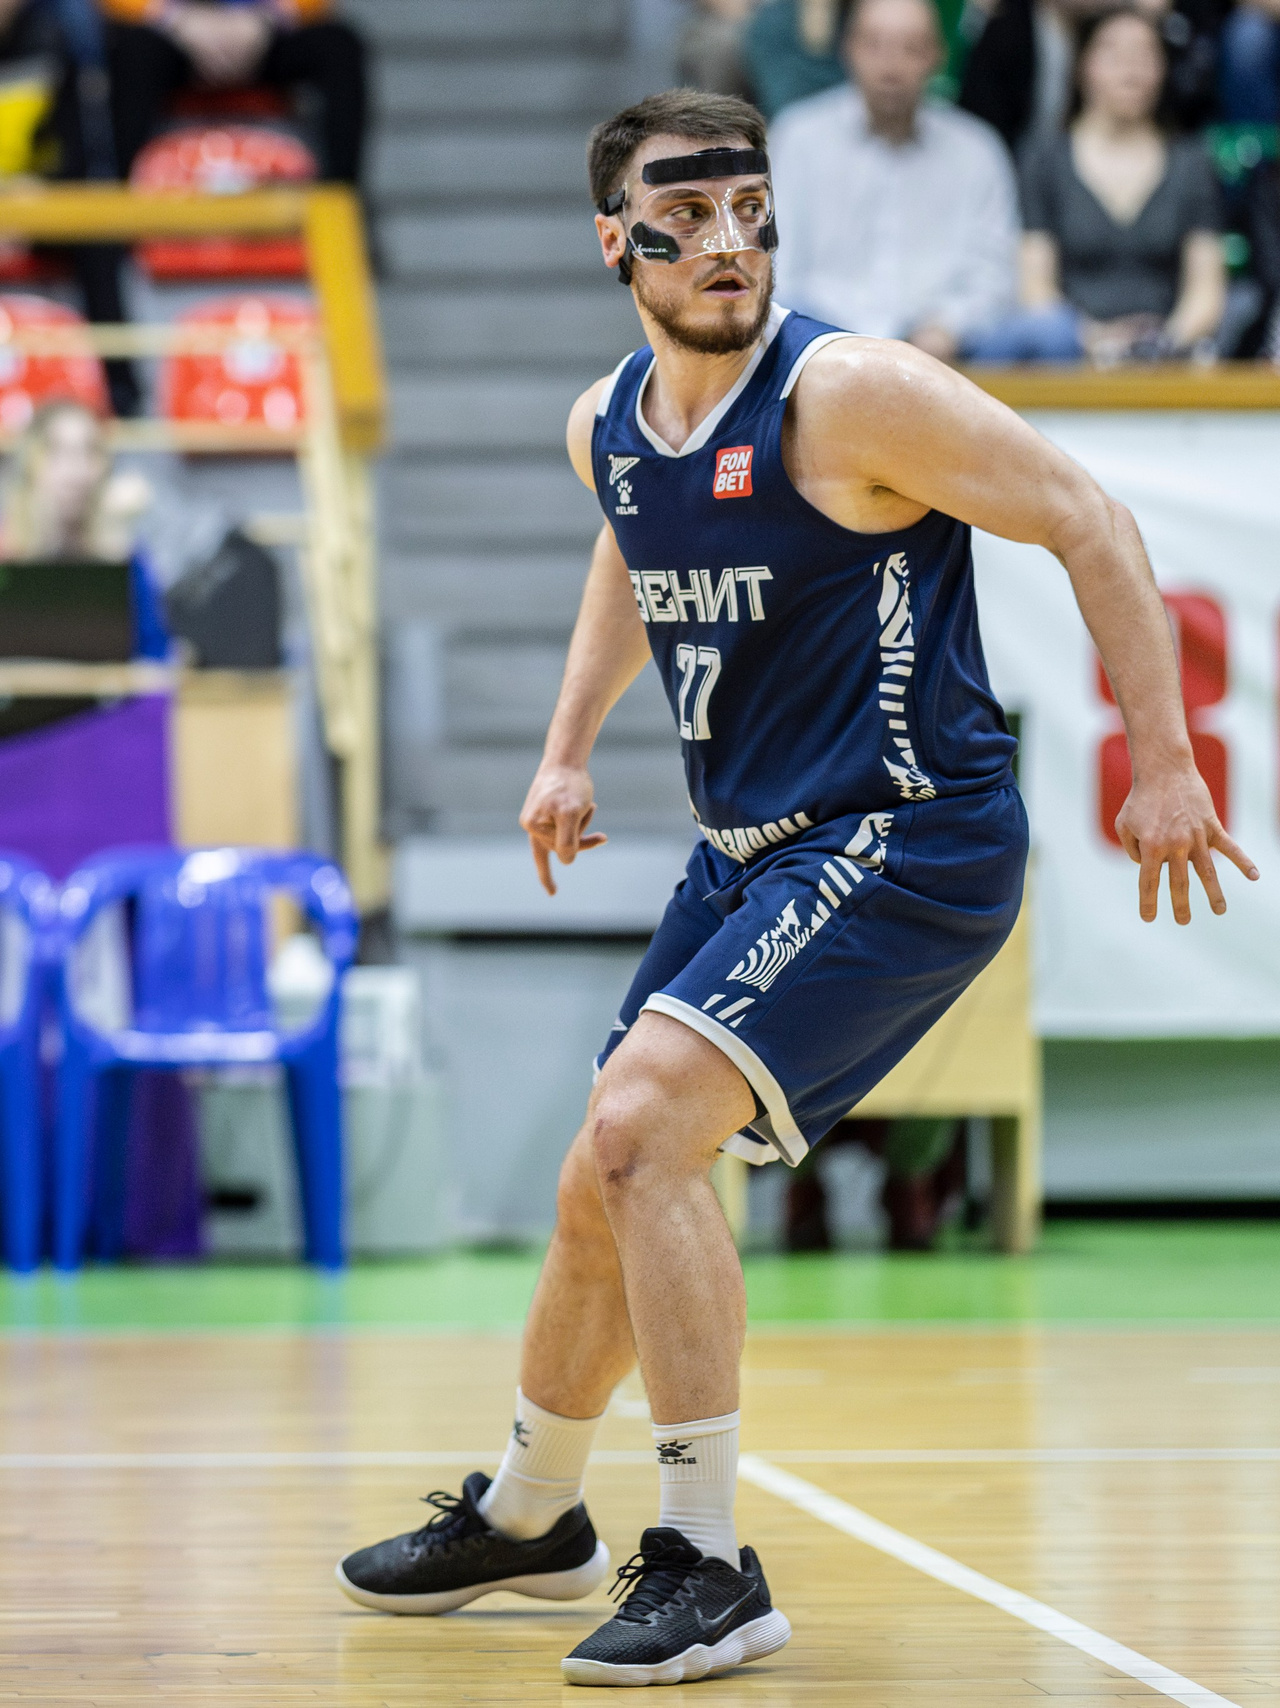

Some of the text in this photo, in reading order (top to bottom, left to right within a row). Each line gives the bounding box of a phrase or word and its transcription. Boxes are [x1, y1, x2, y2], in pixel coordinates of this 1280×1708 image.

[718, 451, 751, 472] FON
[715, 470, 749, 492] BET
[615, 505, 639, 515] KELME
[676, 643, 722, 740] 27
